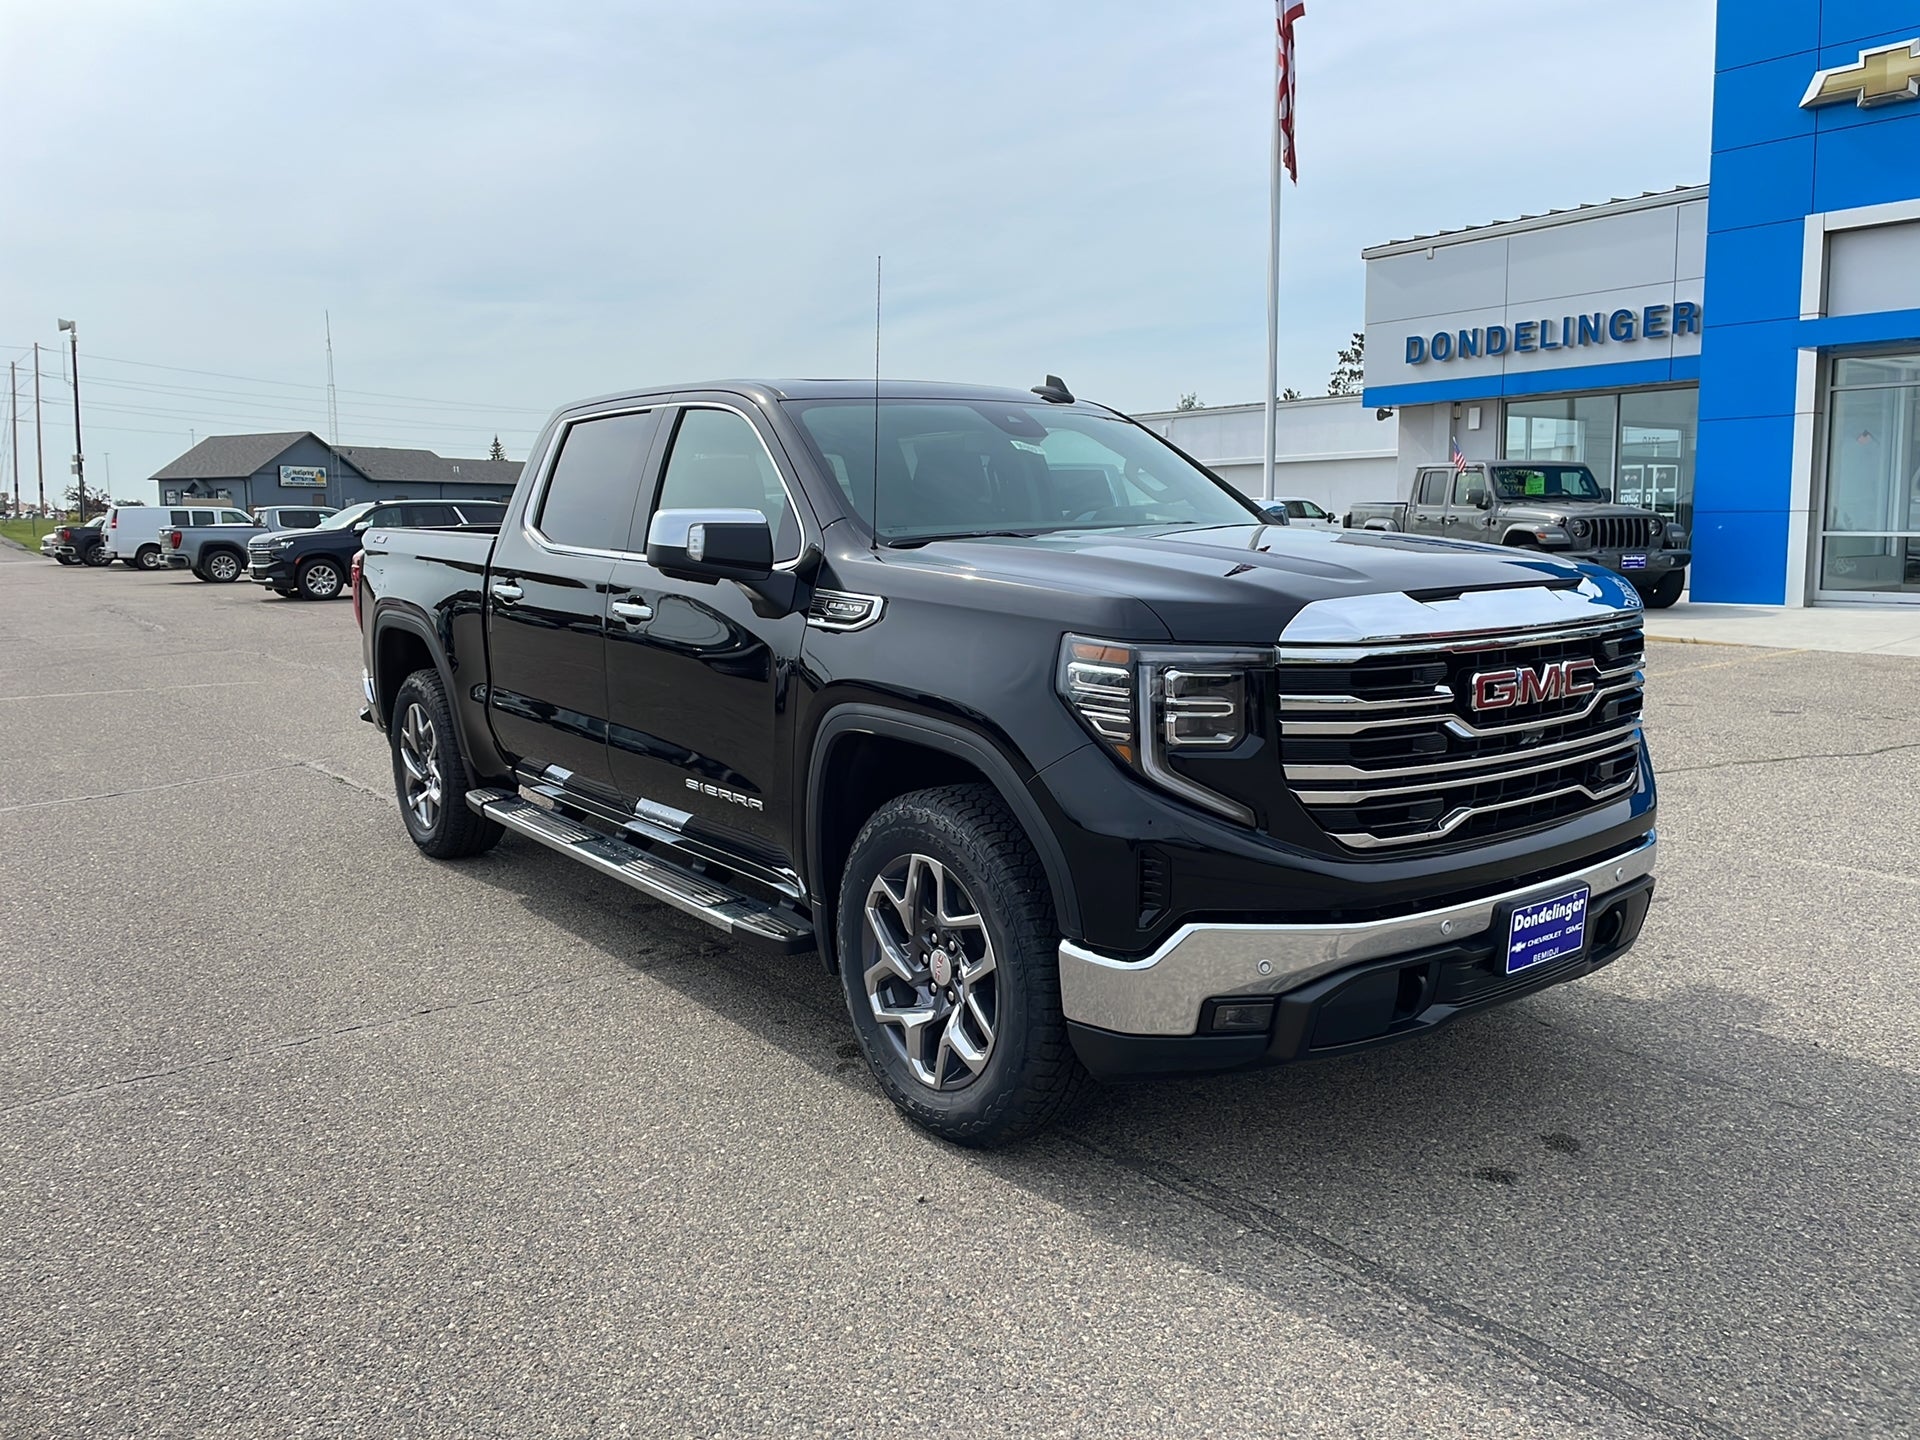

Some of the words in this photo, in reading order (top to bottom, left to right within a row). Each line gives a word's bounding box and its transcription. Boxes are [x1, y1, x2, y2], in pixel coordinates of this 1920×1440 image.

[1405, 301, 1699, 365] DONDELINGER
[1471, 658, 1595, 711] GMC
[685, 778, 763, 811] SIERRA
[1514, 899, 1585, 932] Dondelinger
[1527, 930, 1562, 947] CHEVROLET
[1565, 922, 1583, 935] GMC
[1533, 946, 1560, 963] BEMIDJI
